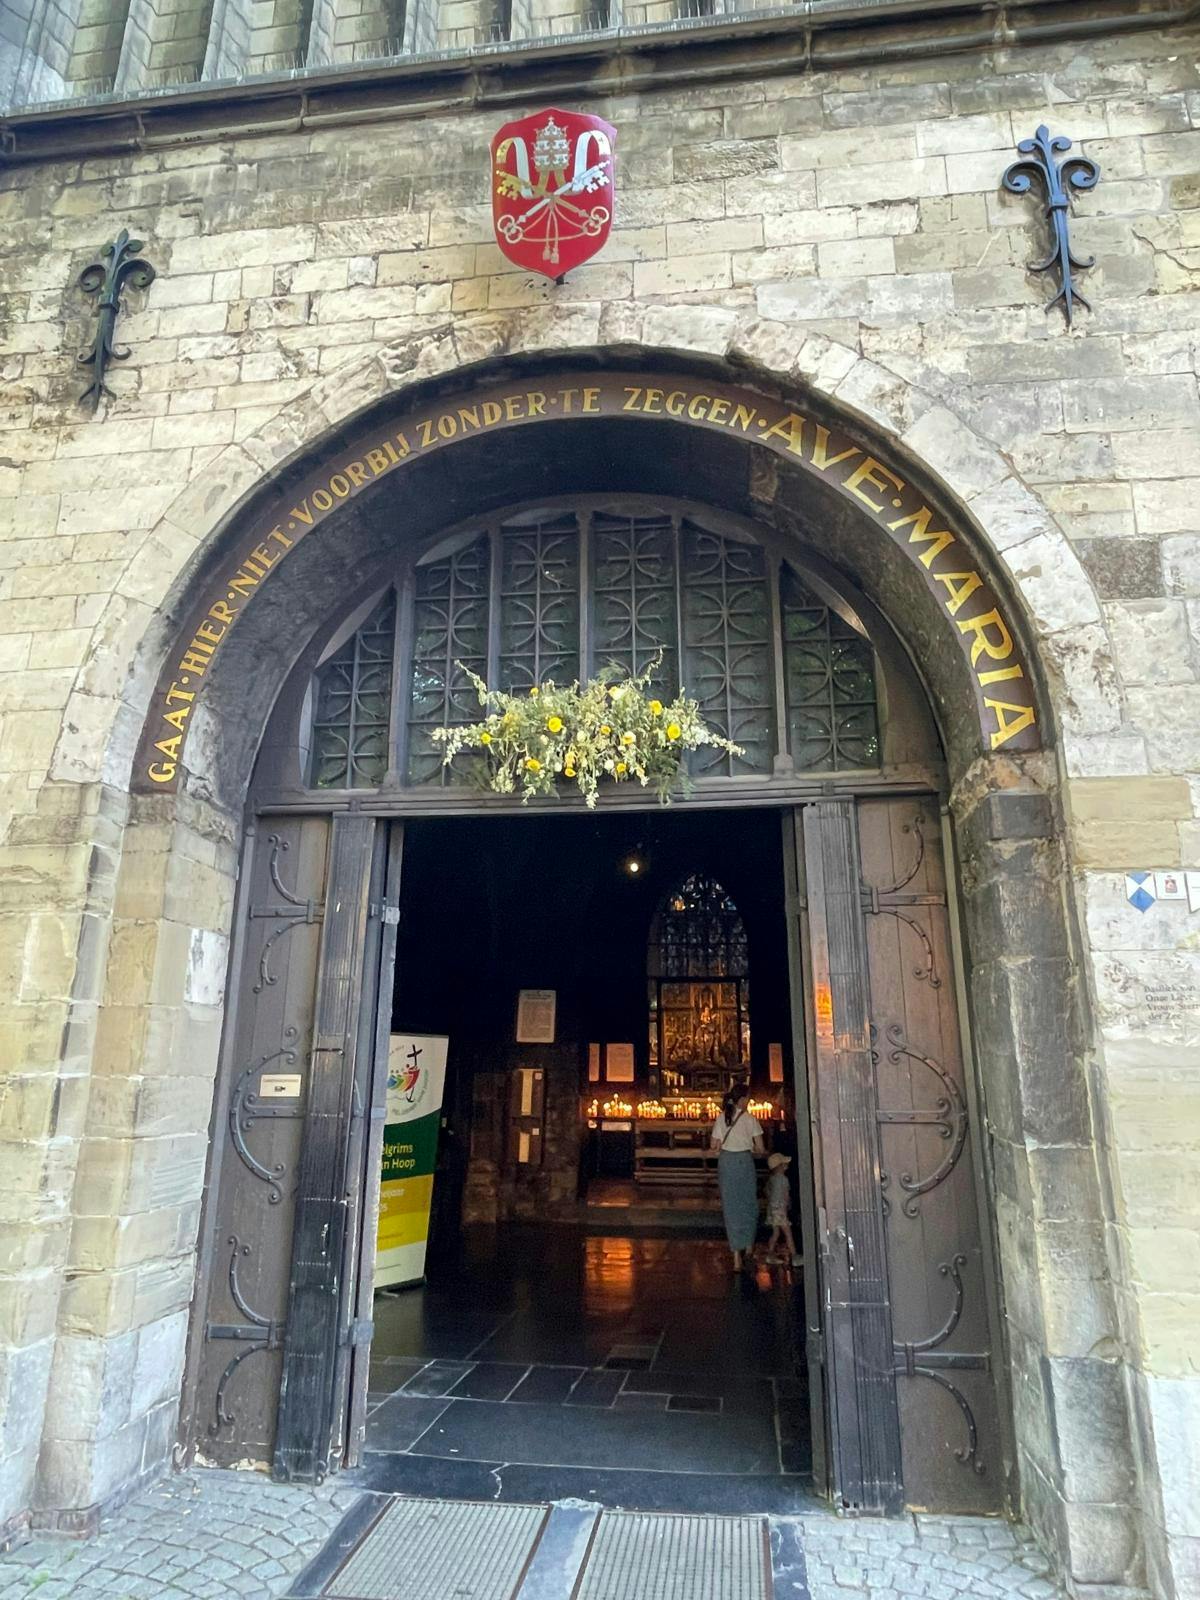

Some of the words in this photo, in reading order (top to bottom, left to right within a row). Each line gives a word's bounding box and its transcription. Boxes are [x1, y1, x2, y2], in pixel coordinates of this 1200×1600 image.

[149, 682, 195, 782] GAAT
[180, 599, 237, 675] HIER
[229, 527, 292, 597] NIET
[291, 433, 409, 527] VOORBIJ
[416, 392, 549, 447] ZONDER
[559, 388, 600, 412] TE
[623, 387, 758, 431] ZEGGEN
[758, 413, 904, 513] AVE
[887, 505, 1036, 750] MARIA
[391, 1158, 416, 1169] Hoop
